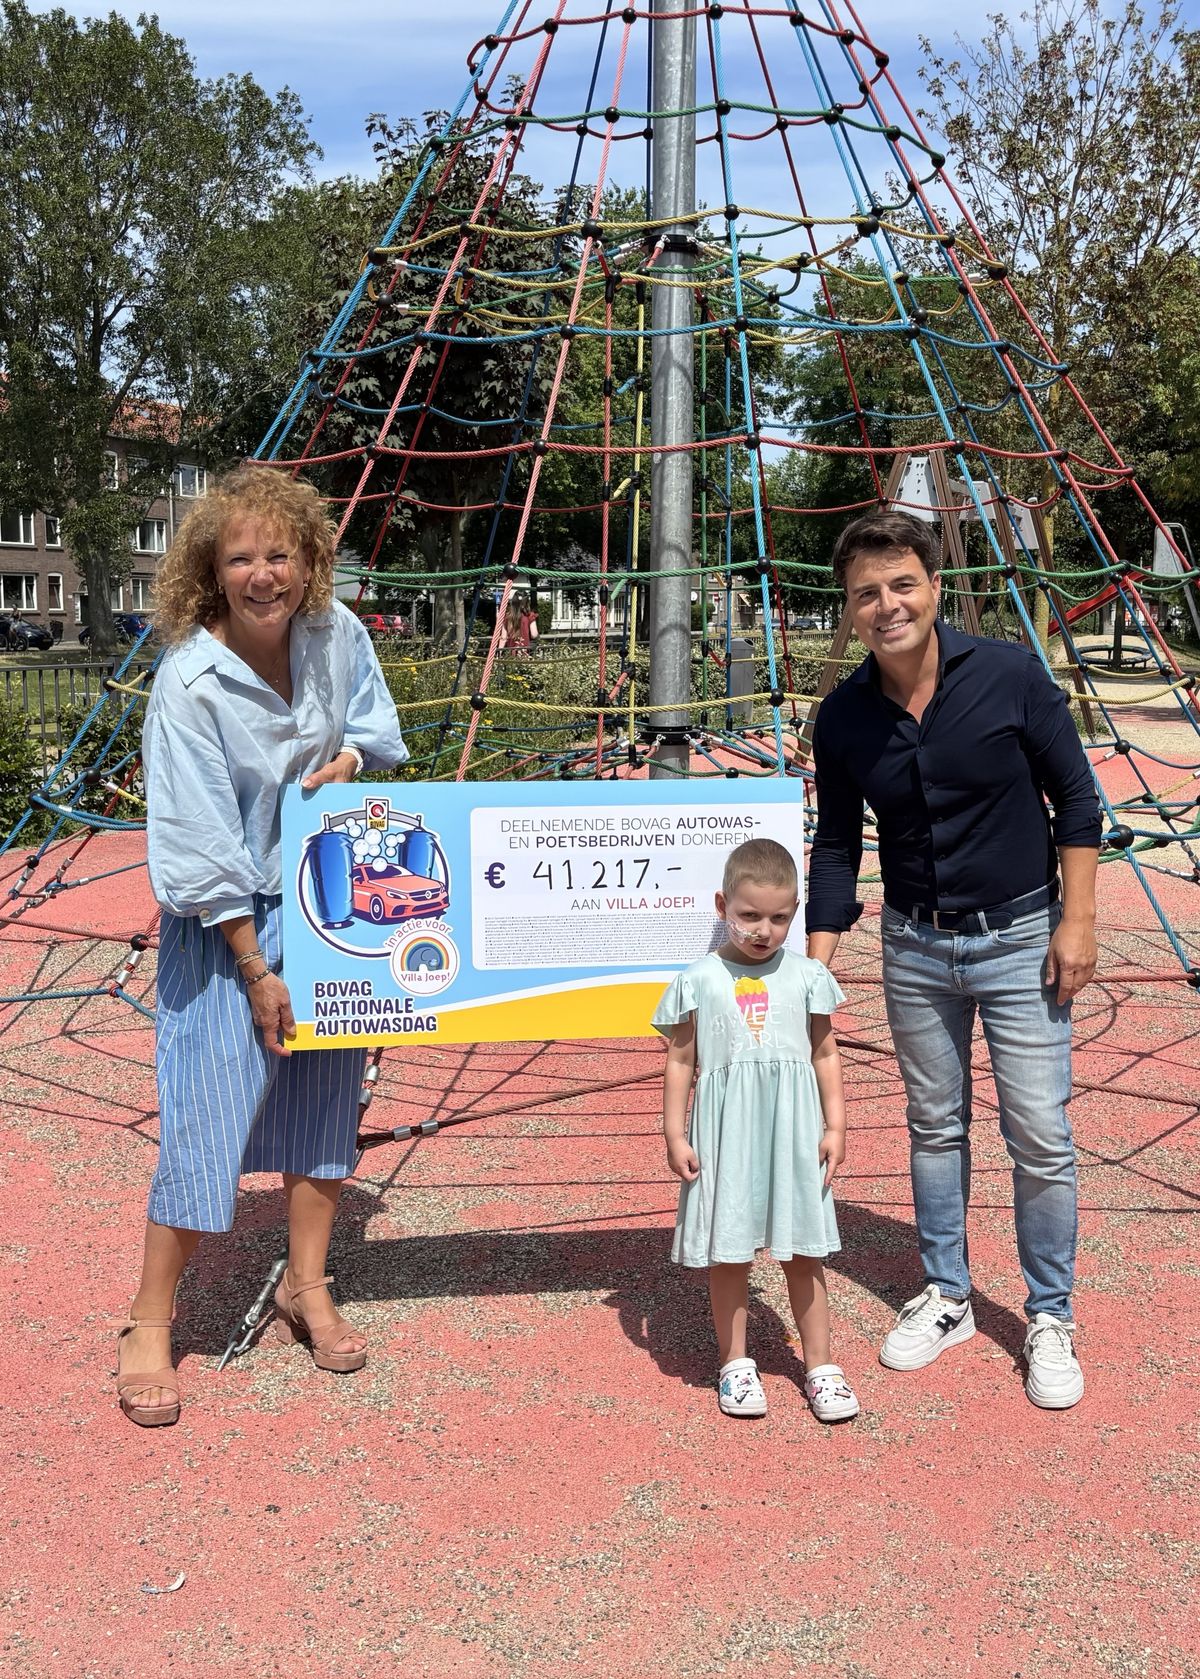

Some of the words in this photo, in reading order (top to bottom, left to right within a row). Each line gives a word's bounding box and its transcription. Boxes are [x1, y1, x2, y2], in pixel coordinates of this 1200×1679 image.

[501, 818, 615, 833] DEELNEMENDE
[621, 817, 671, 831] BOVAG
[676, 816, 761, 830] AUTOWAS-
[509, 836, 530, 849] EN
[536, 833, 675, 848] POETSBEDRIJVEN
[681, 832, 754, 846] DONEREN
[484, 862, 506, 889] €
[571, 898, 601, 910] AAN
[606, 897, 648, 910] VILLA
[653, 896, 695, 909] JOEP!
[385, 936, 398, 948] in
[396, 920, 422, 938] actie
[425, 920, 451, 934] voor
[401, 973, 423, 982] Villa
[425, 972, 450, 983] Joep!
[314, 981, 372, 998] BOVAG
[314, 998, 414, 1017] NATIONALE
[315, 1016, 437, 1037] AUTOWASDAG
